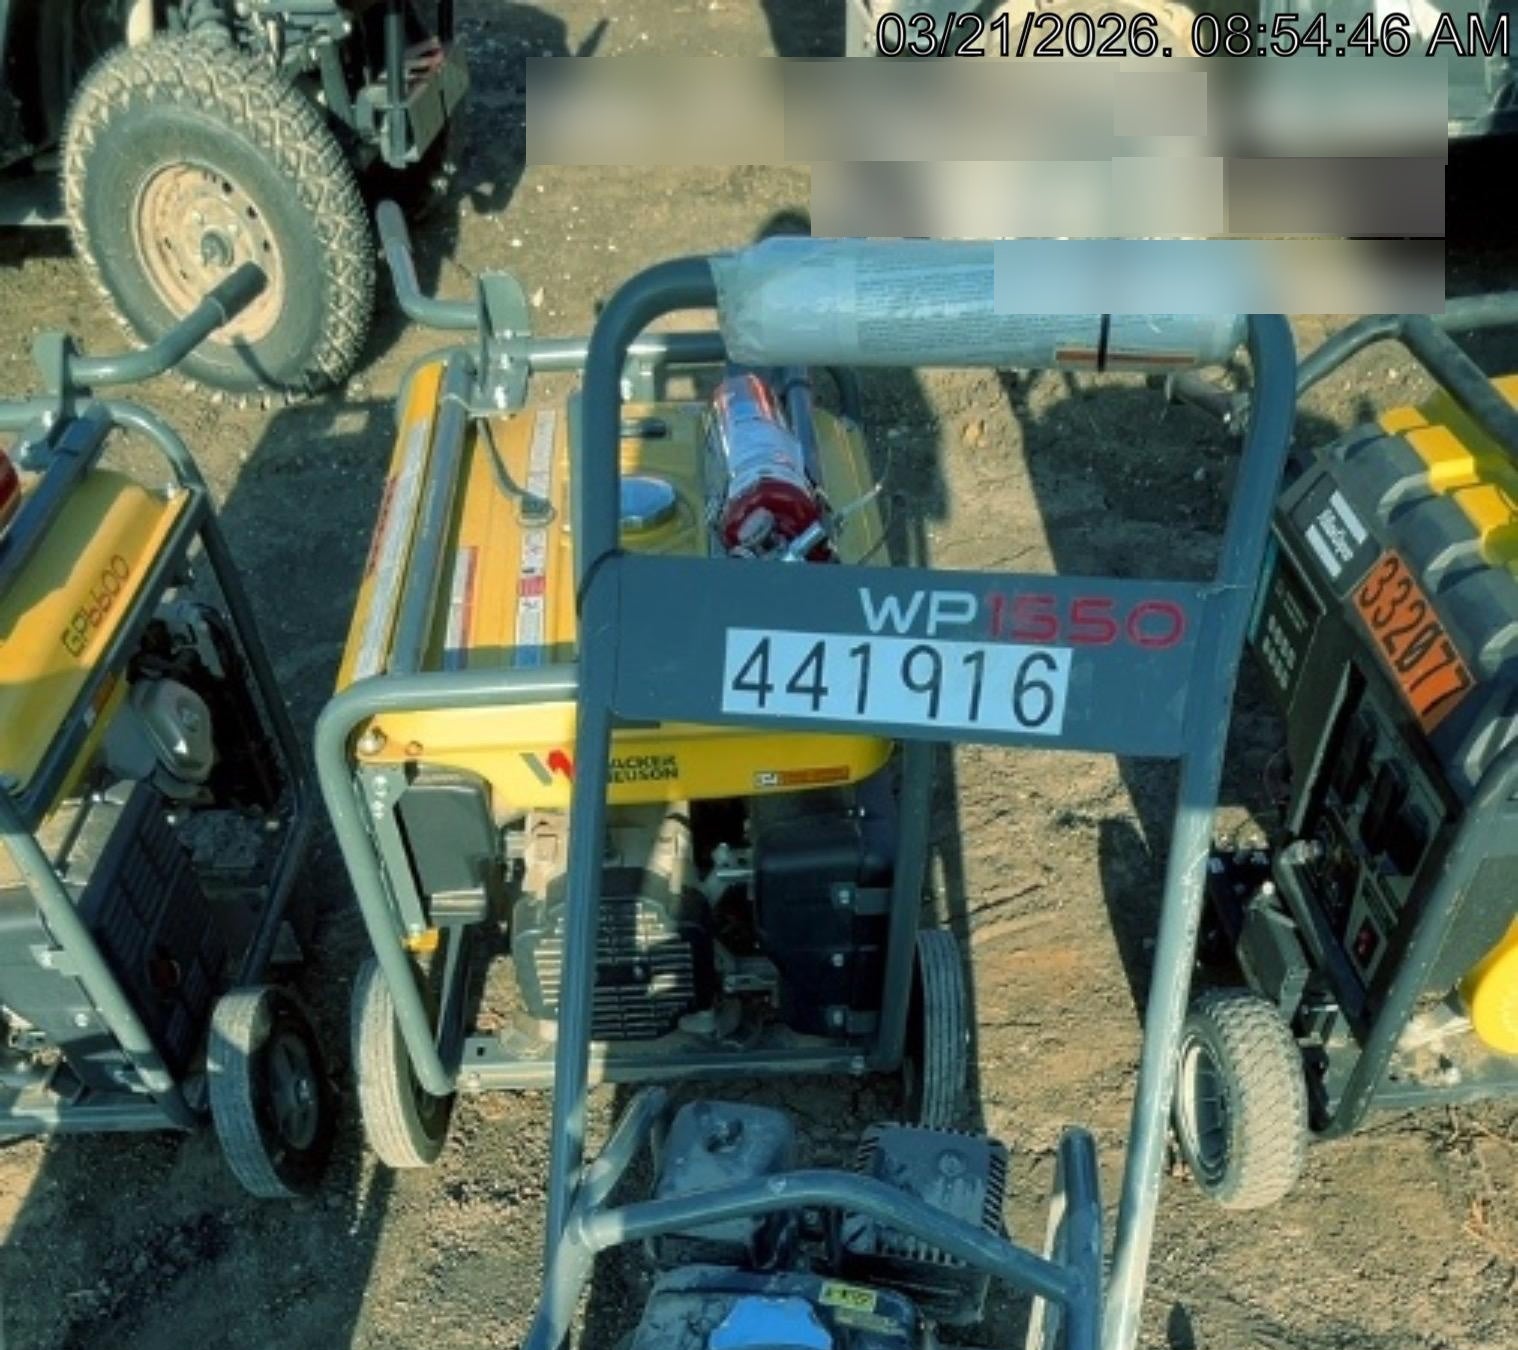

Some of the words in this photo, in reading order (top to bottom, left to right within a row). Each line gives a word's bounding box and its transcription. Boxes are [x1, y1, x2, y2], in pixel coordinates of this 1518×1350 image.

[61, 554, 129, 657] GP6600
[859, 587, 1187, 649] WP1550
[1358, 556, 1472, 717] 332077
[731, 636, 1058, 728] 441916
[610, 755, 676, 768] ACKER
